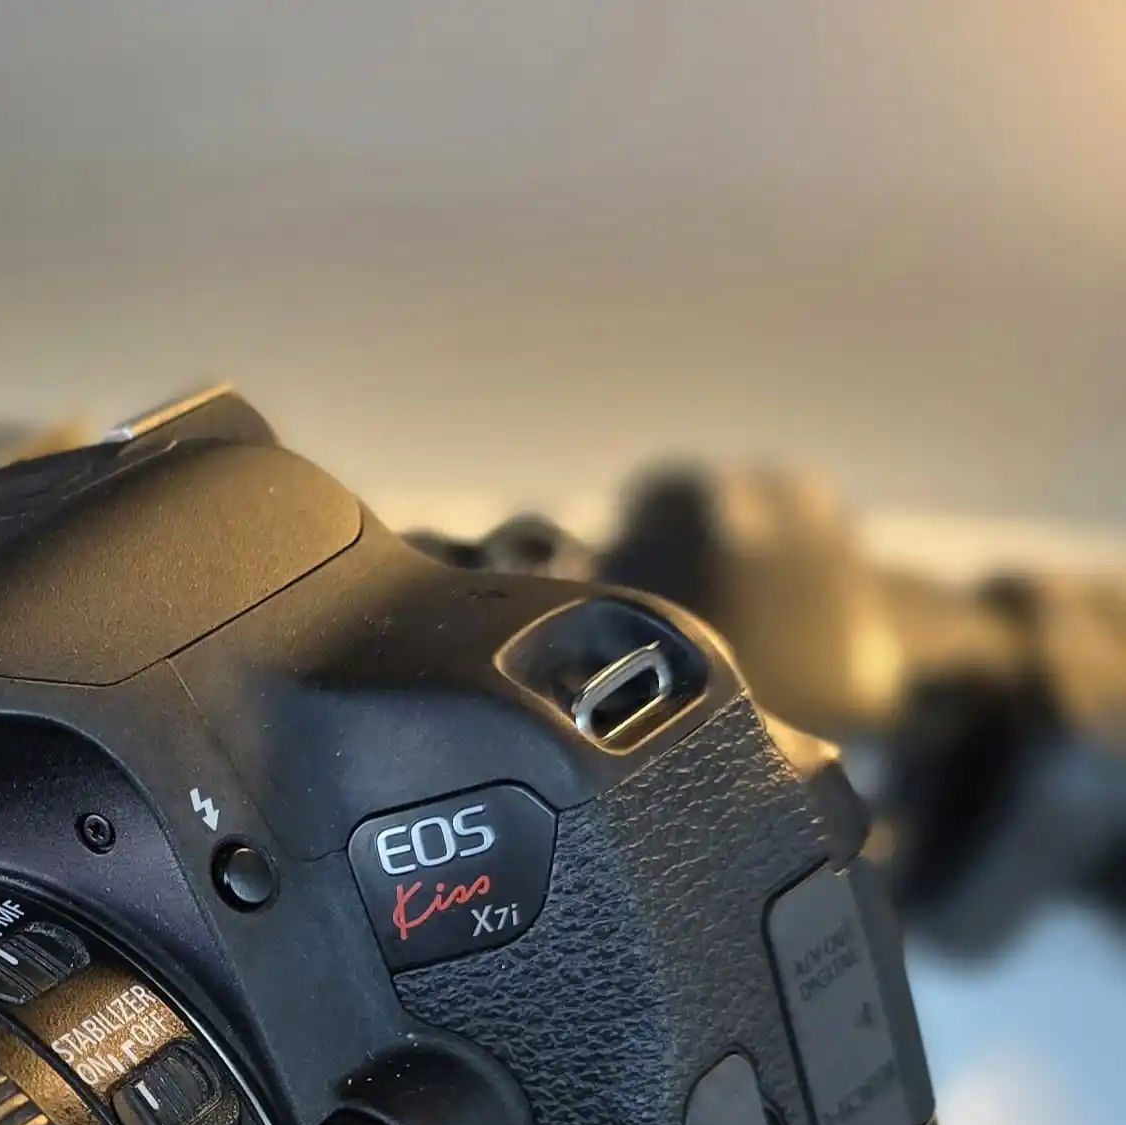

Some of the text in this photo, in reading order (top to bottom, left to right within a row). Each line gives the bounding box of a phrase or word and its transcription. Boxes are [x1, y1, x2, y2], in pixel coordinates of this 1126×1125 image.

[376, 803, 496, 876] EOS
[393, 875, 491, 941] Kiss
[471, 903, 519, 937] X7i
[51, 984, 154, 1065] STABILIZER
